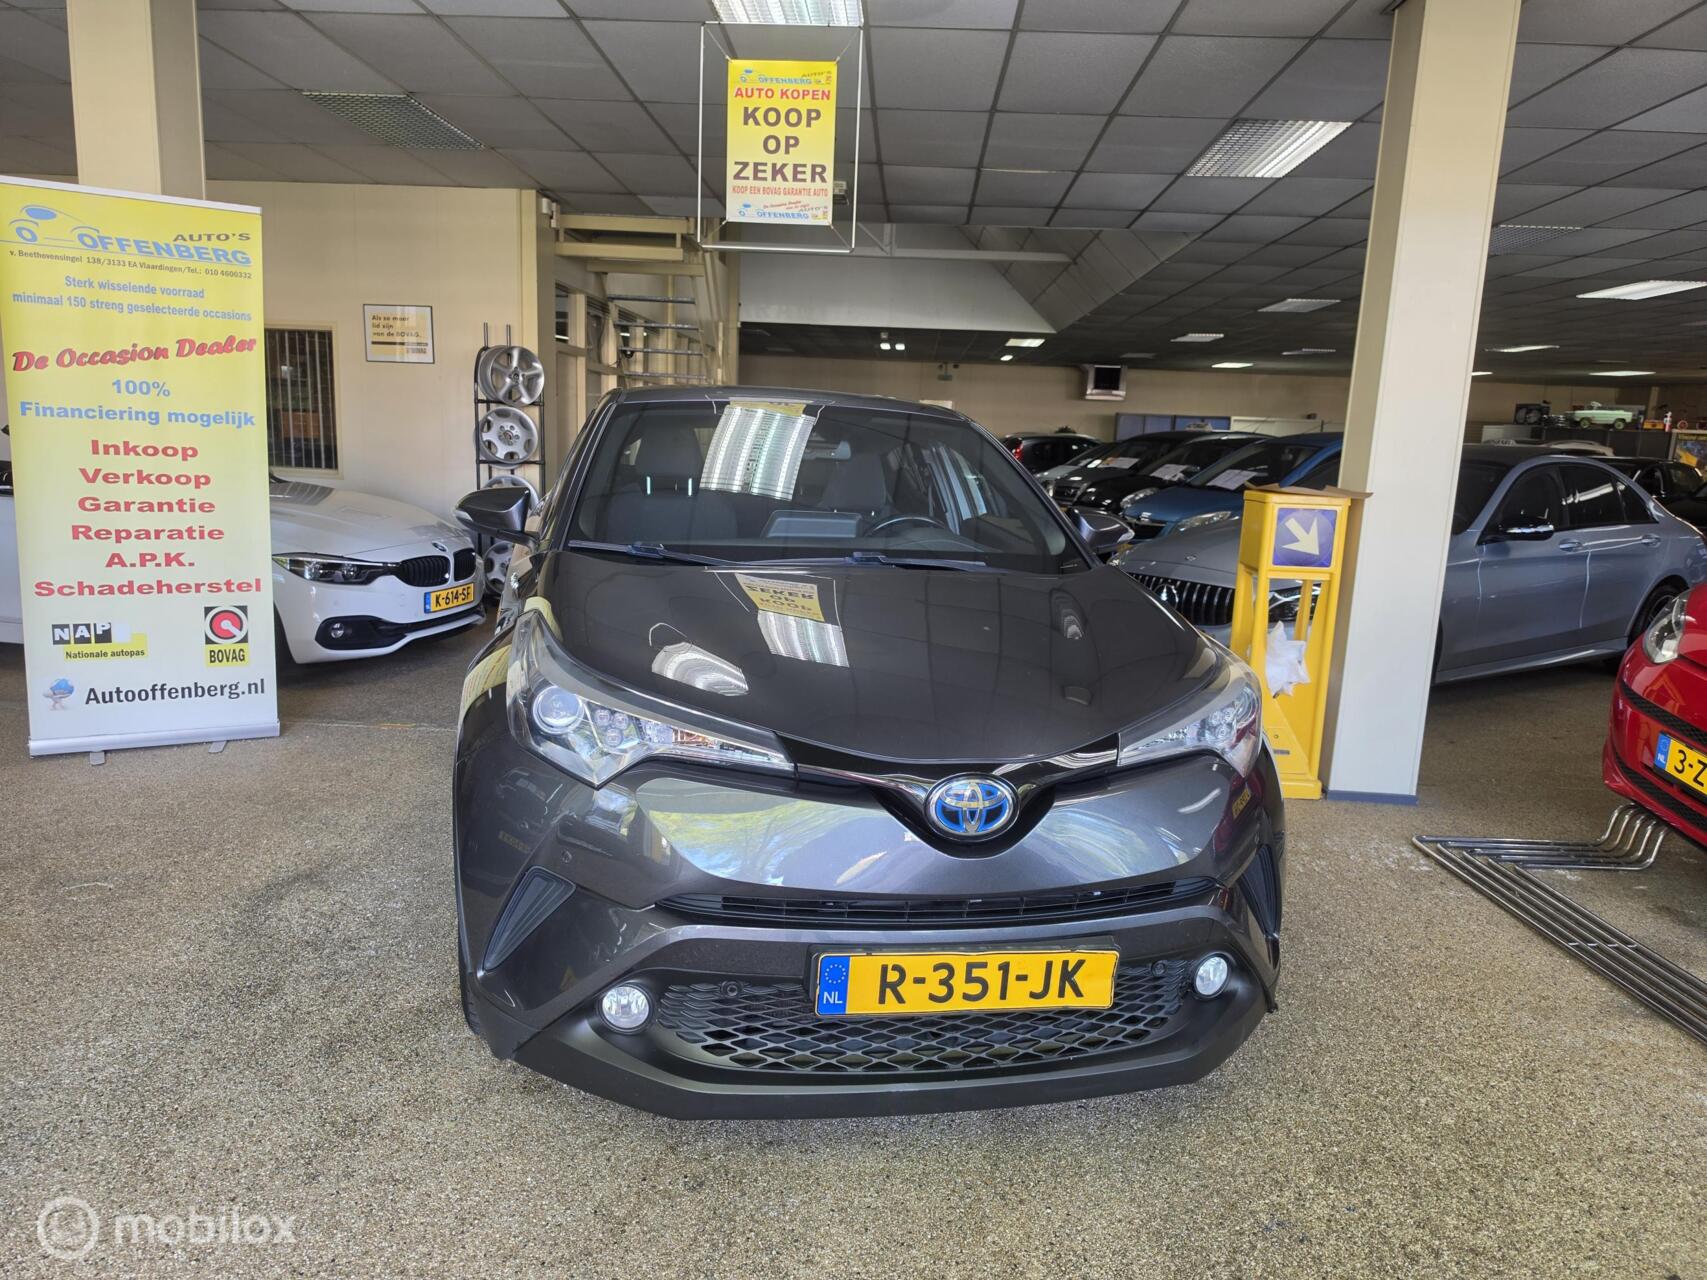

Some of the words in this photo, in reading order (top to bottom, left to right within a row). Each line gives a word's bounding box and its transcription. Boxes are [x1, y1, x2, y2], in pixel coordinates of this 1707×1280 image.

[734, 87, 775, 99] AUTO
[780, 88, 831, 101] KOPEN
[743, 106, 821, 128] KOOP
[762, 135, 800, 155] OP
[733, 161, 828, 183] ZEKER
[732, 185, 748, 194] KOOP
[750, 186, 761, 195] EEN
[762, 186, 782, 196] BOVAG
[783, 187, 812, 197] GARANTIE
[813, 188, 828, 197] AUTO
[757, 211, 809, 220] OFFENBERG
[173, 232, 251, 242] AUTO'S
[77, 232, 251, 265] OFFENBERG
[18, 249, 83, 263] Beethovensingel
[128, 260, 138, 268] EA
[205, 268, 218, 276] 010
[65, 275, 95, 288] Sterk
[97, 279, 157, 294] wisselende
[160, 287, 205, 298] voorraad
[12, 292, 64, 306] minimaal
[67, 295, 86, 308] 150
[89, 299, 124, 314] streng
[127, 303, 200, 317] geselecteerde
[202, 309, 252, 322] occasions
[12, 350, 49, 372] De
[56, 343, 169, 369] Occasion
[175, 335, 257, 358] Dealer
[111, 379, 171, 397] 100%
[20, 401, 160, 425] Financiering
[167, 410, 256, 429] mogelijk
[91, 439, 199, 462] Inkoop
[78, 467, 211, 489] Verkoop
[77, 496, 216, 513] Garantie
[71, 524, 225, 543] Reparatie
[105, 552, 195, 568] A.P.K.
[34, 578, 262, 597] Schadeherstel
[435, 586, 471, 608] K-614-SF
[53, 622, 112, 642] NAP
[65, 650, 109, 659] Nationale
[110, 649, 145, 658] autopas
[209, 648, 246, 663] BOVAG
[85, 678, 265, 705] Autooffenberg.nl
[878, 959, 1086, 1005] R-351-JK
[823, 991, 843, 1004] NL
